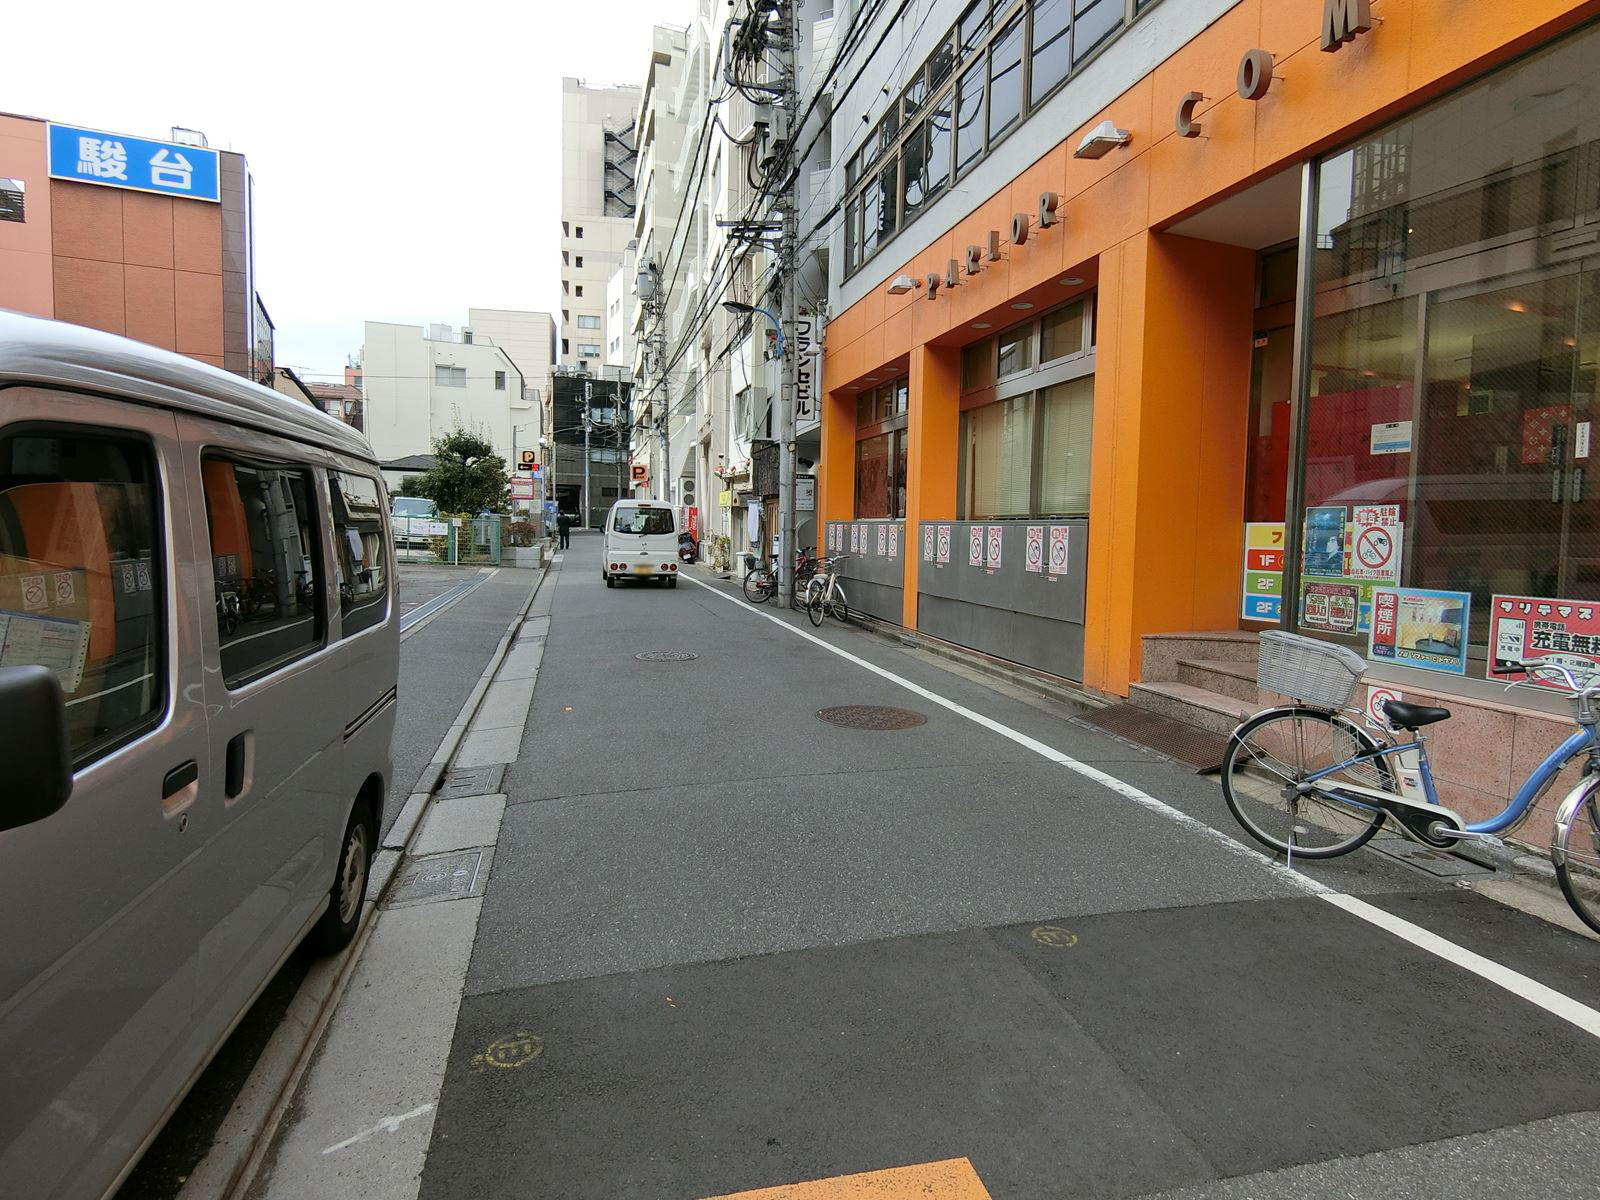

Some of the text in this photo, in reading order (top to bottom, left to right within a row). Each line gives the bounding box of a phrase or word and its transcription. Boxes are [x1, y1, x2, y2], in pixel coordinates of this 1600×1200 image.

[76, 136, 193, 190] 駿台
[927, 191, 1058, 300] PARLOR
[524, 451, 534, 462] P
[632, 466, 646, 479] P
[1259, 554, 1275, 567] 1F
[1257, 578, 1274, 590] 2F
[1256, 602, 1273, 614] 2F
[1376, 594, 1394, 636] 喫煙所
